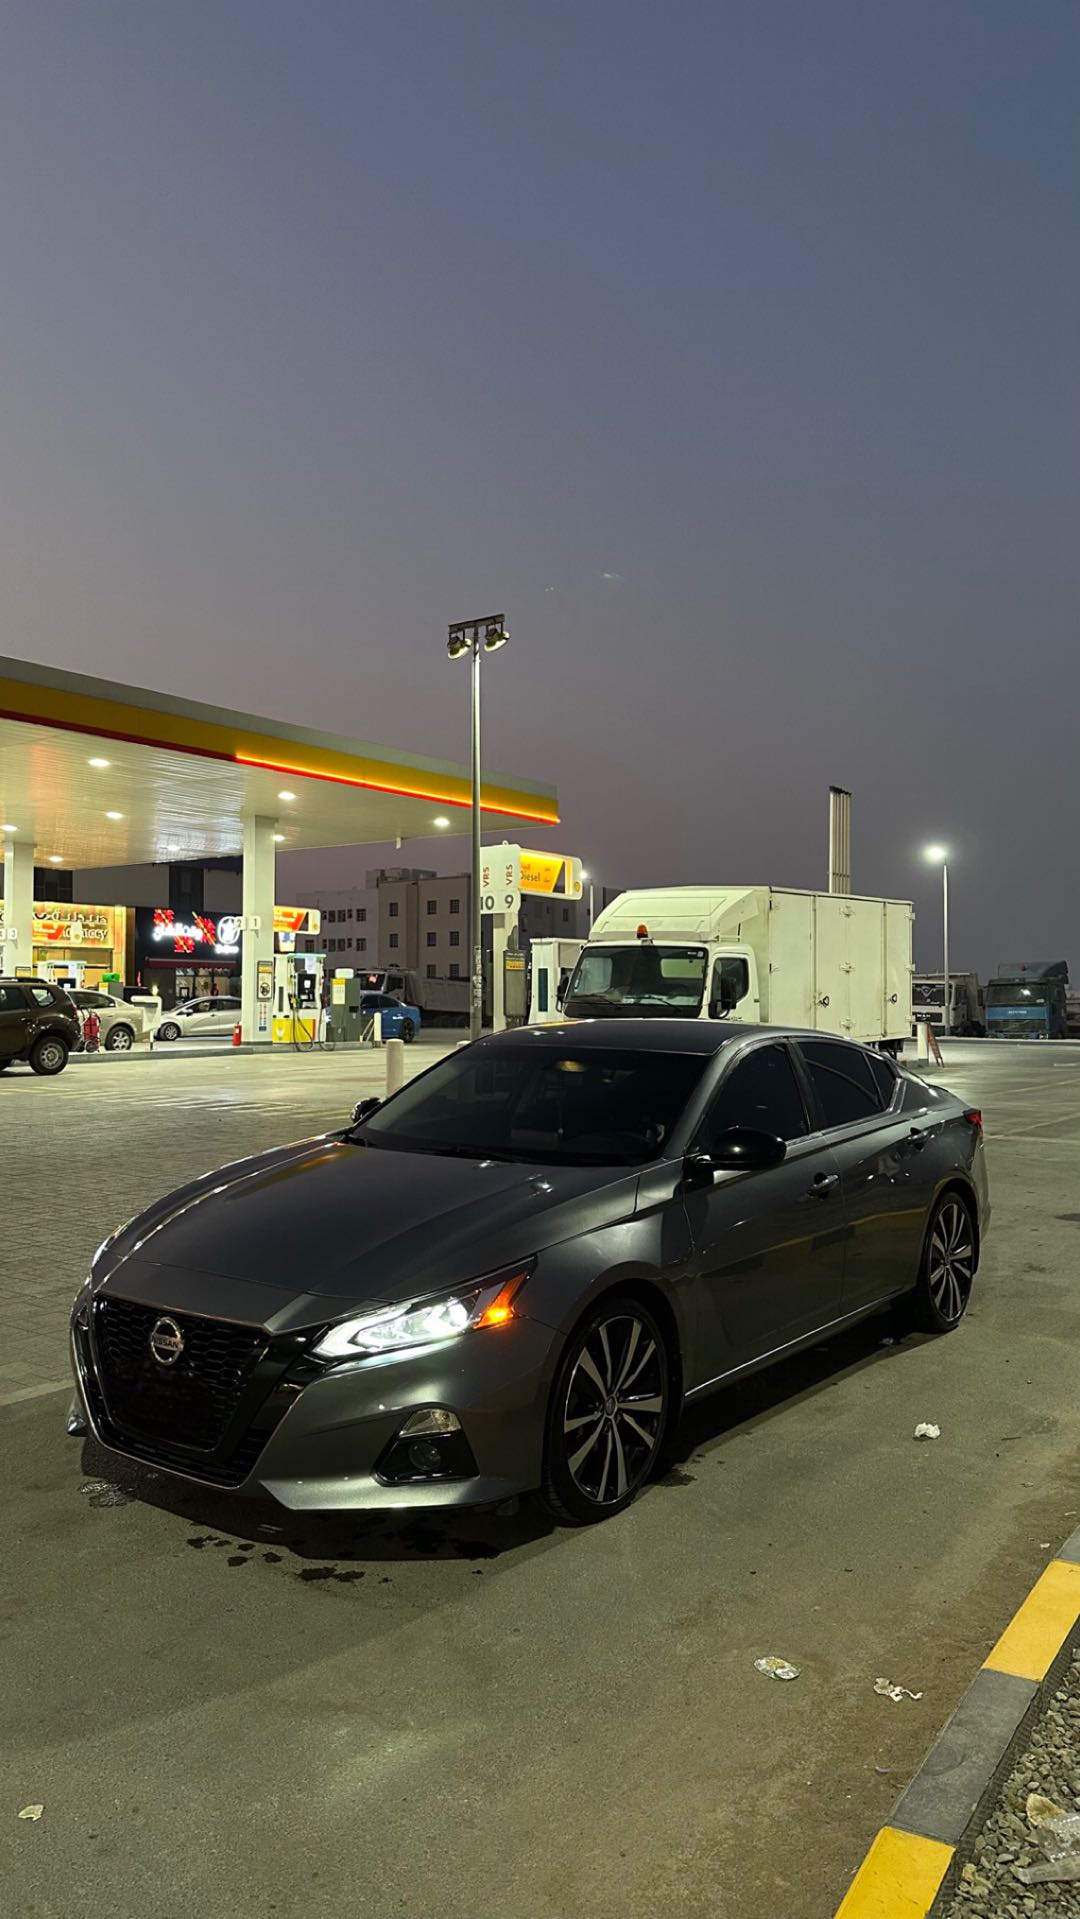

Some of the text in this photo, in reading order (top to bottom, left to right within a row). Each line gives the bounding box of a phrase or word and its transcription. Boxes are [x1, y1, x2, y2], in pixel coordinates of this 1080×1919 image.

[482, 866, 490, 888] VRS
[505, 864, 513, 886] VRS
[480, 895, 495, 911] 10
[504, 894, 514, 909] 9
[152, 1333, 180, 1350] NISSAN
